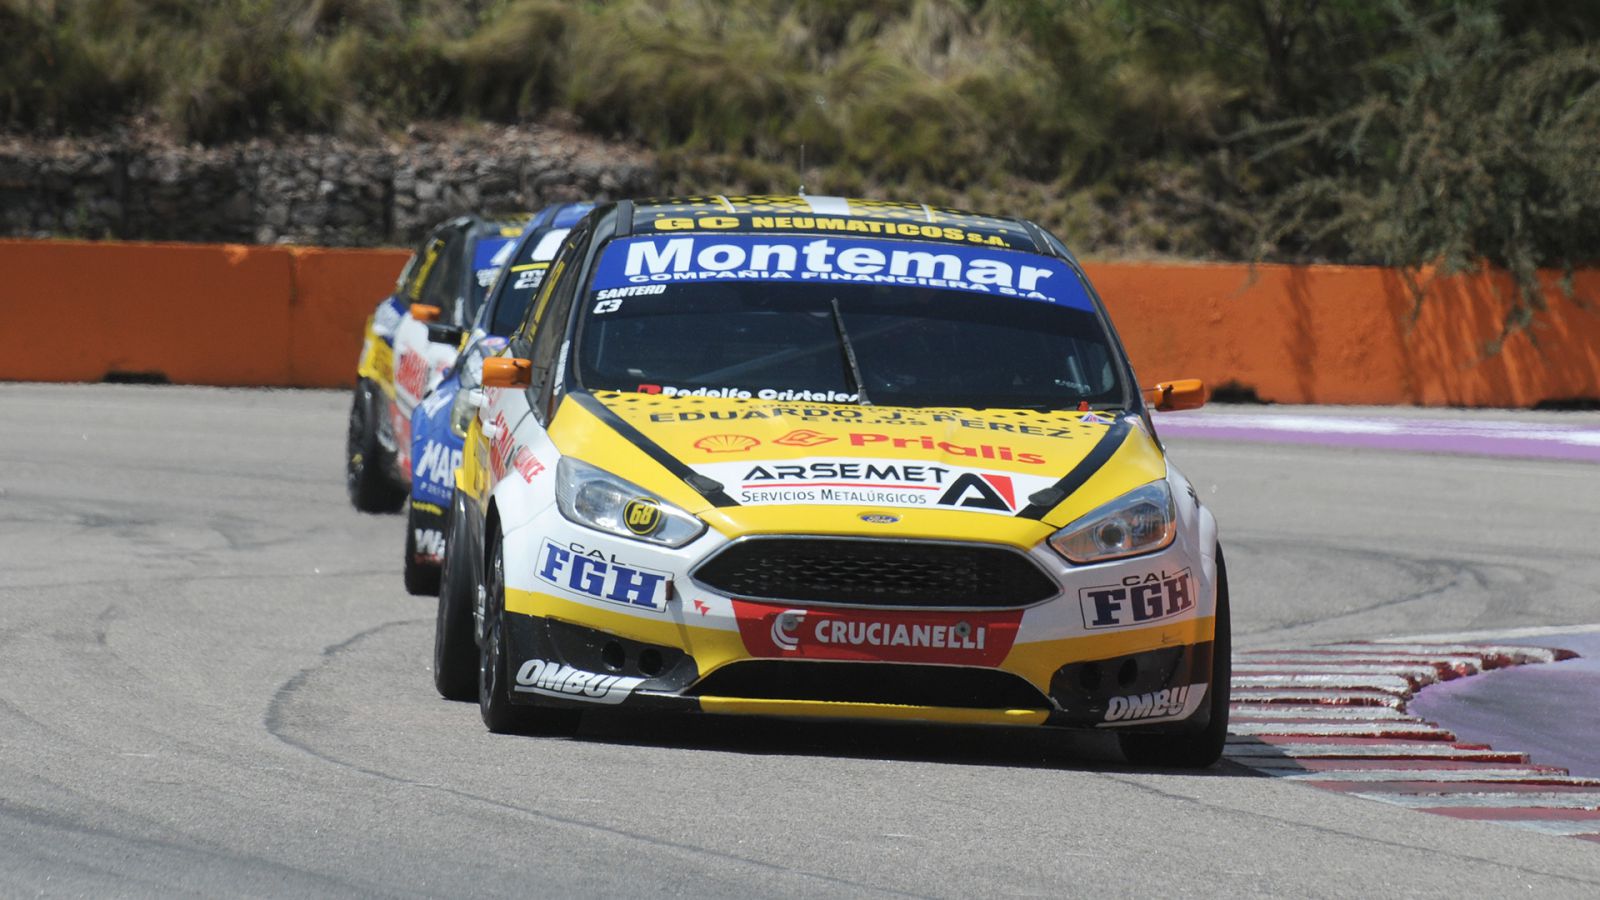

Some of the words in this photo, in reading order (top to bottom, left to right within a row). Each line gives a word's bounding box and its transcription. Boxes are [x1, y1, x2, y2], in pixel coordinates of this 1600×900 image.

[654, 216, 740, 231] GC
[752, 217, 965, 241] NEUMATICOS
[967, 232, 1011, 248] S.A.
[624, 237, 1054, 291] Montemar
[596, 284, 667, 300] SANTERO
[801, 271, 991, 292] FINANCIERA
[999, 286, 1056, 302] S.A.
[593, 298, 623, 314] C3
[662, 386, 752, 400] Rodolfo
[757, 388, 860, 403] Cristales
[649, 408, 863, 423] EDUARDO
[880, 412, 916, 421] J.
[932, 413, 1074, 440] PEREZ
[849, 433, 1046, 465] Prialis
[742, 462, 950, 484] ARSEMET
[742, 490, 815, 502] SERVICIOS
[820, 489, 927, 505] METALÚRGICOS
[630, 502, 655, 526] 68
[569, 542, 627, 565] CAL
[540, 543, 666, 609] FGH
[1122, 570, 1173, 587] CAL
[1087, 573, 1191, 626] FGH
[814, 619, 986, 650] CRUCIANELLI
